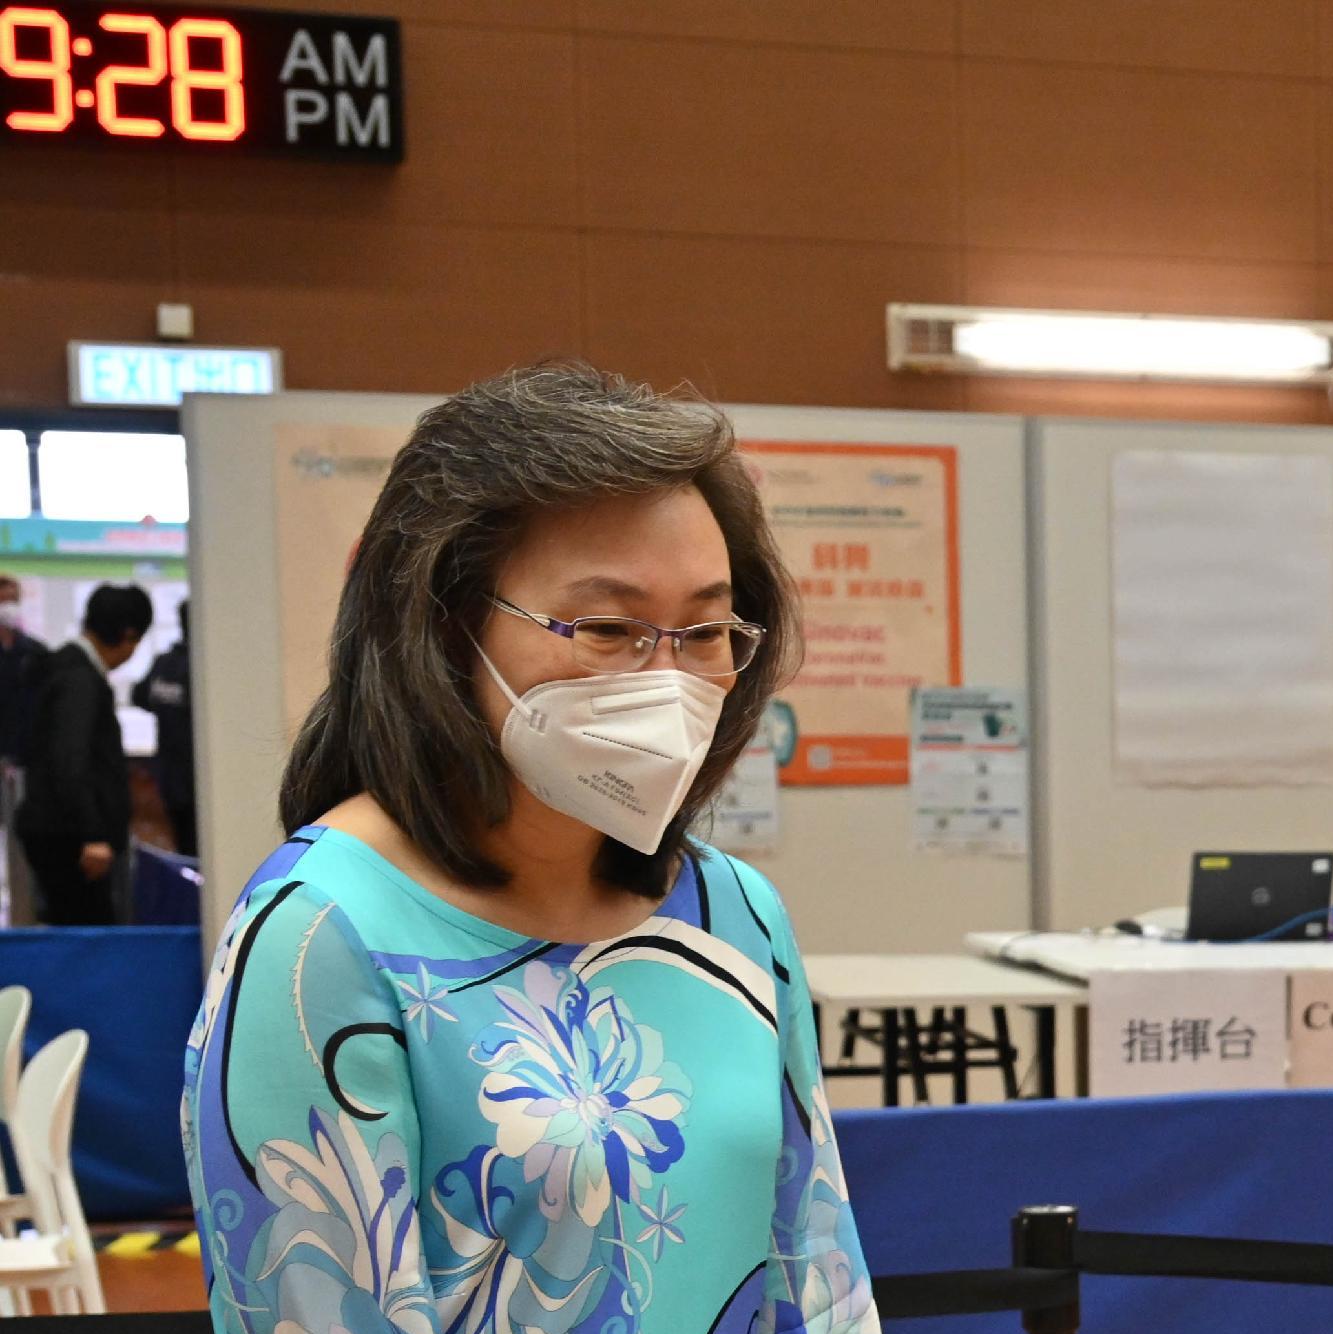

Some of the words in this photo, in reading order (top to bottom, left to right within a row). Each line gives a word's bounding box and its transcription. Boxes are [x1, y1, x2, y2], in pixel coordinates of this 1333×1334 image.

[0, 7, 246, 142] 9:28
[279, 29, 389, 89] AM
[285, 88, 391, 149] PM
[92, 352, 183, 399] EXIT
[1122, 1016, 1257, 1063] 指揮台
